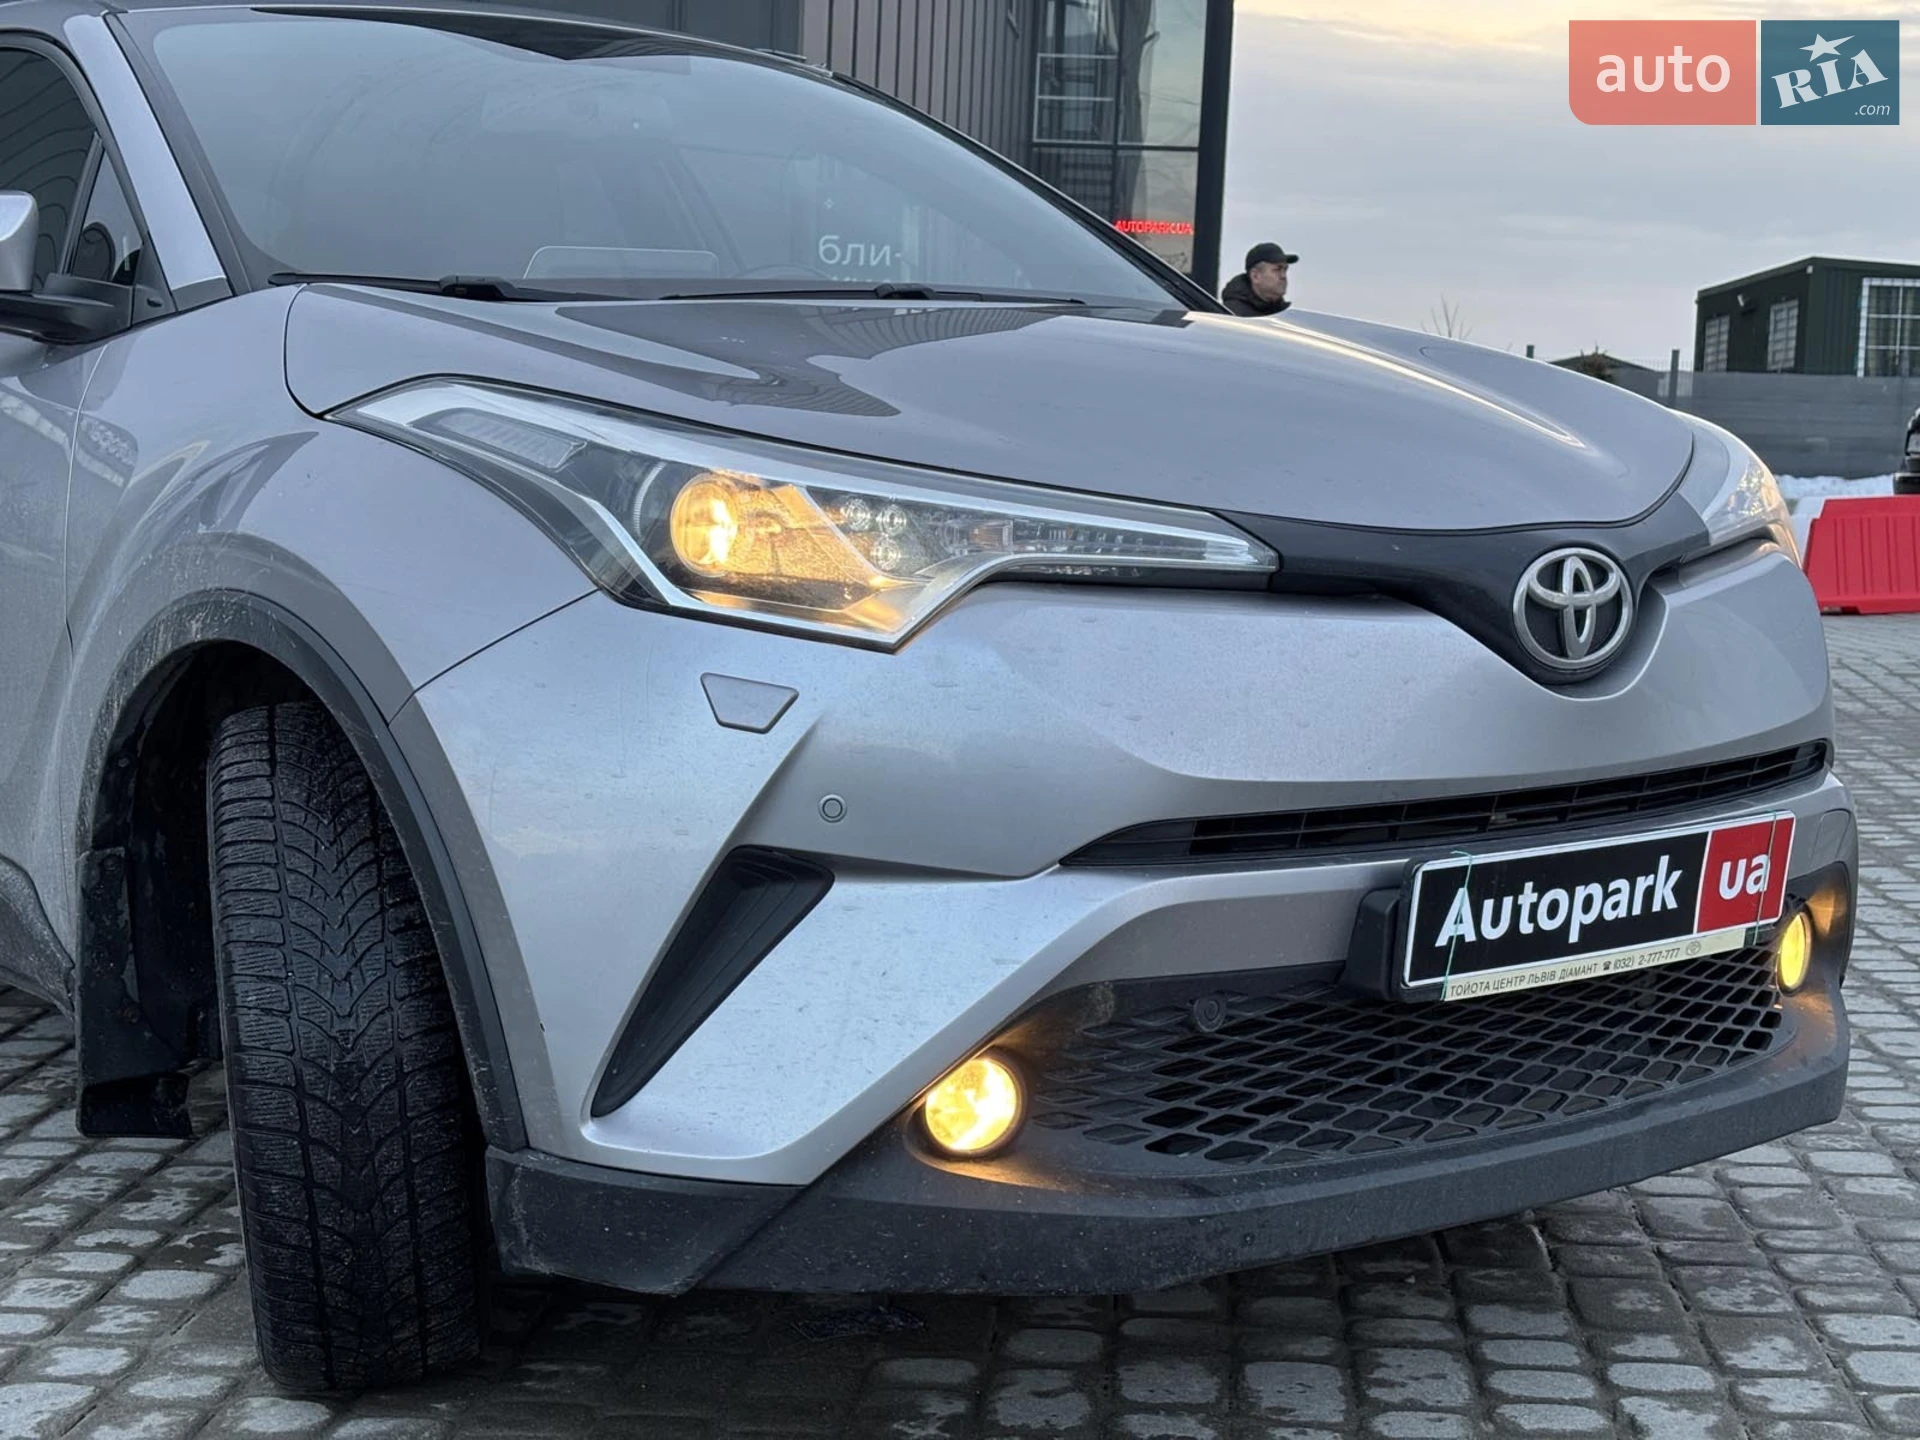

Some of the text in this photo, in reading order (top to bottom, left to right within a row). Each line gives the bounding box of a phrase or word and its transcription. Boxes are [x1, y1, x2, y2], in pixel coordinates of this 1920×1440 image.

[1434, 853, 1771, 948] Autopark ua
[1450, 947, 1681, 997] ТОЙОТА ЦЕНТР ЛЬВІВ ДІАМАНТ (032) 2-777-777
